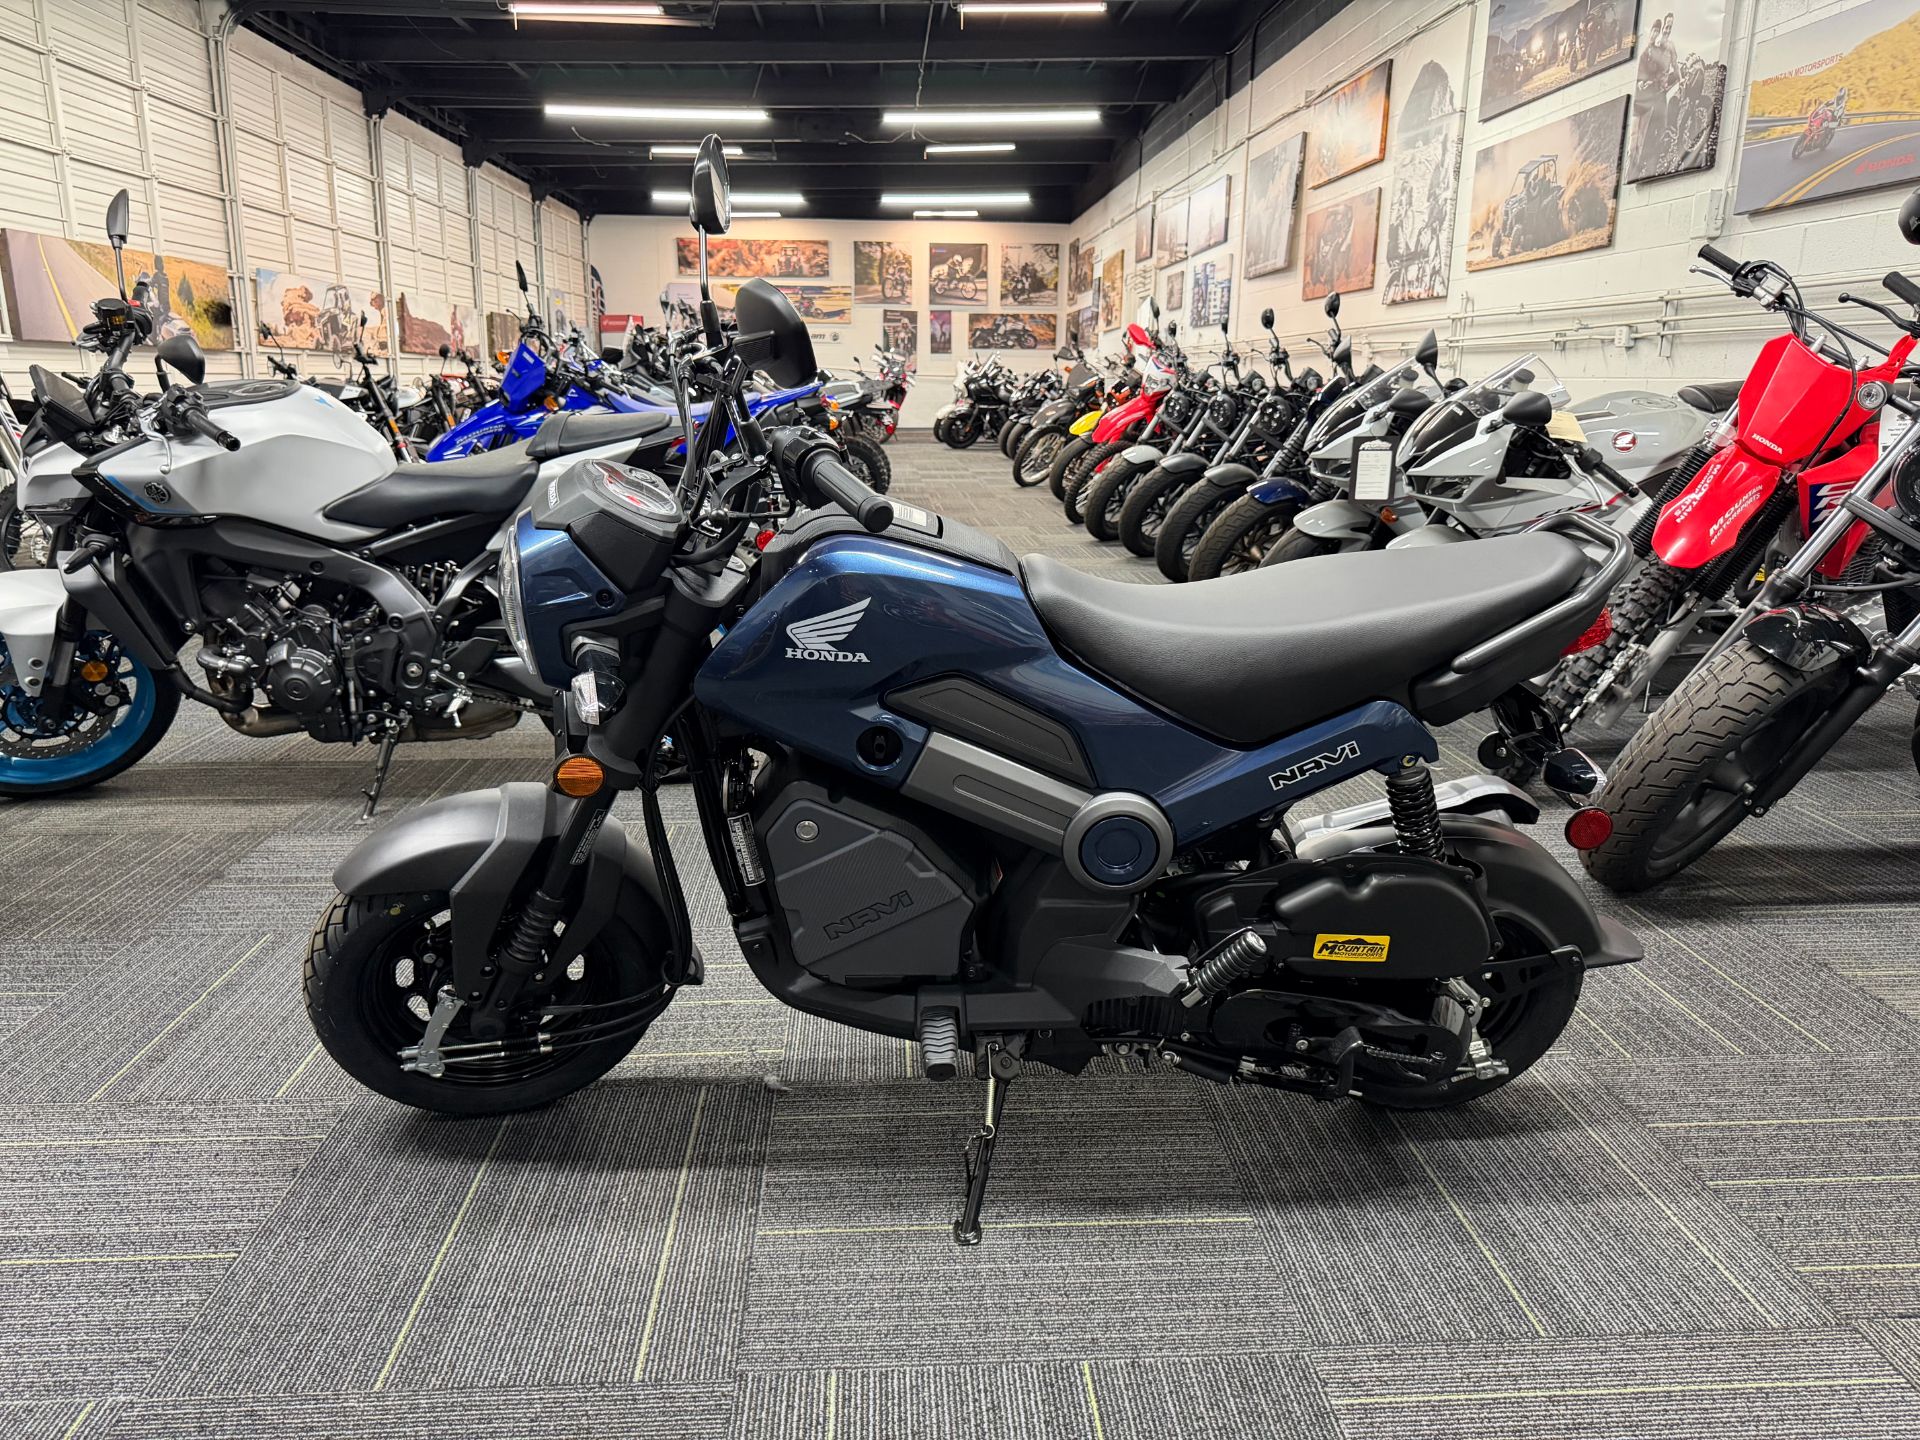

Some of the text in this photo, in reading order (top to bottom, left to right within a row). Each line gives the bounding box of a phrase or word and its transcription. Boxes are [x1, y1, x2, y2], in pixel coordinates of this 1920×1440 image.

[1762, 52, 1844, 87] MOUNTAIN MOTORSPORTS
[1751, 432, 1783, 455] HONDA
[1709, 484, 1764, 537] MOUNTAIN
[1710, 492, 1761, 545] MOTORSPORTS
[784, 647, 871, 663] HONDA
[1317, 943, 1386, 955] MOUNTAIN
